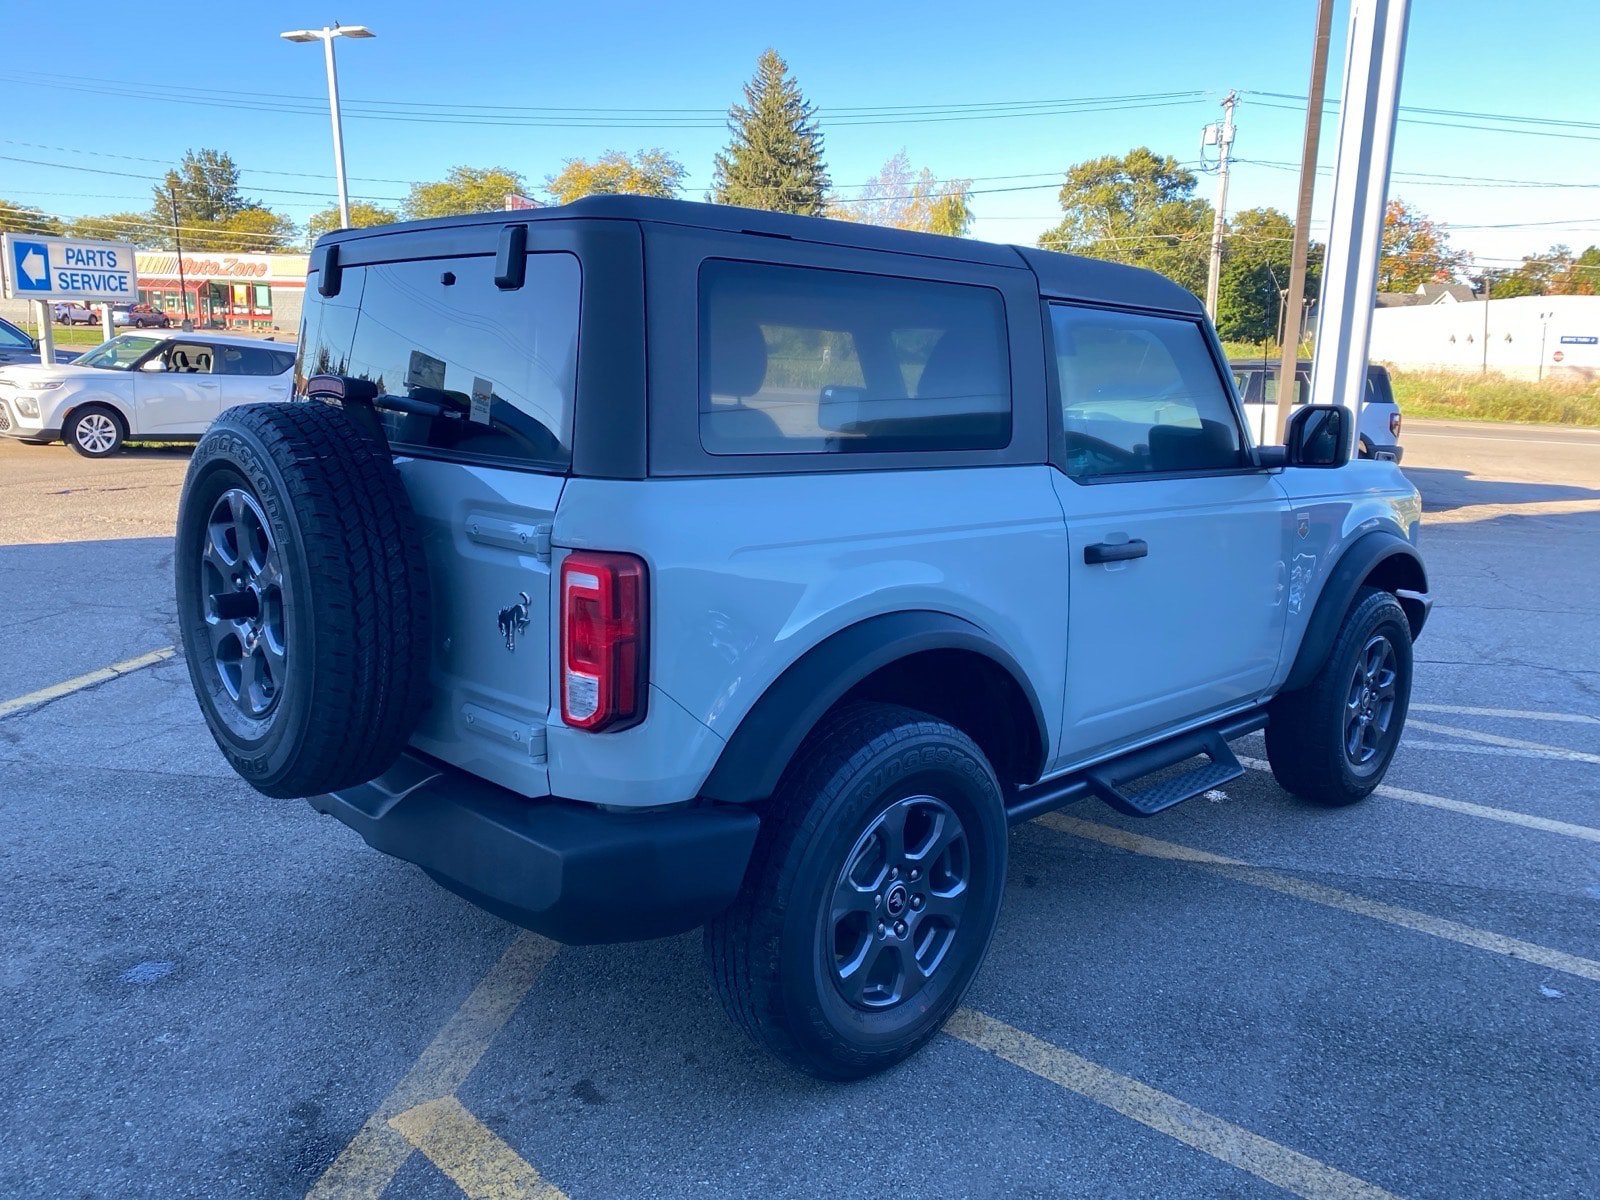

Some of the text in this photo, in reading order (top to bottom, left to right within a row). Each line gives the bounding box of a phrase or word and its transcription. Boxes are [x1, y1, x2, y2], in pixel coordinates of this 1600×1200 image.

[65, 248, 117, 268] PARTS
[179, 257, 268, 277] AutoZone
[58, 272, 128, 291] SERVICE
